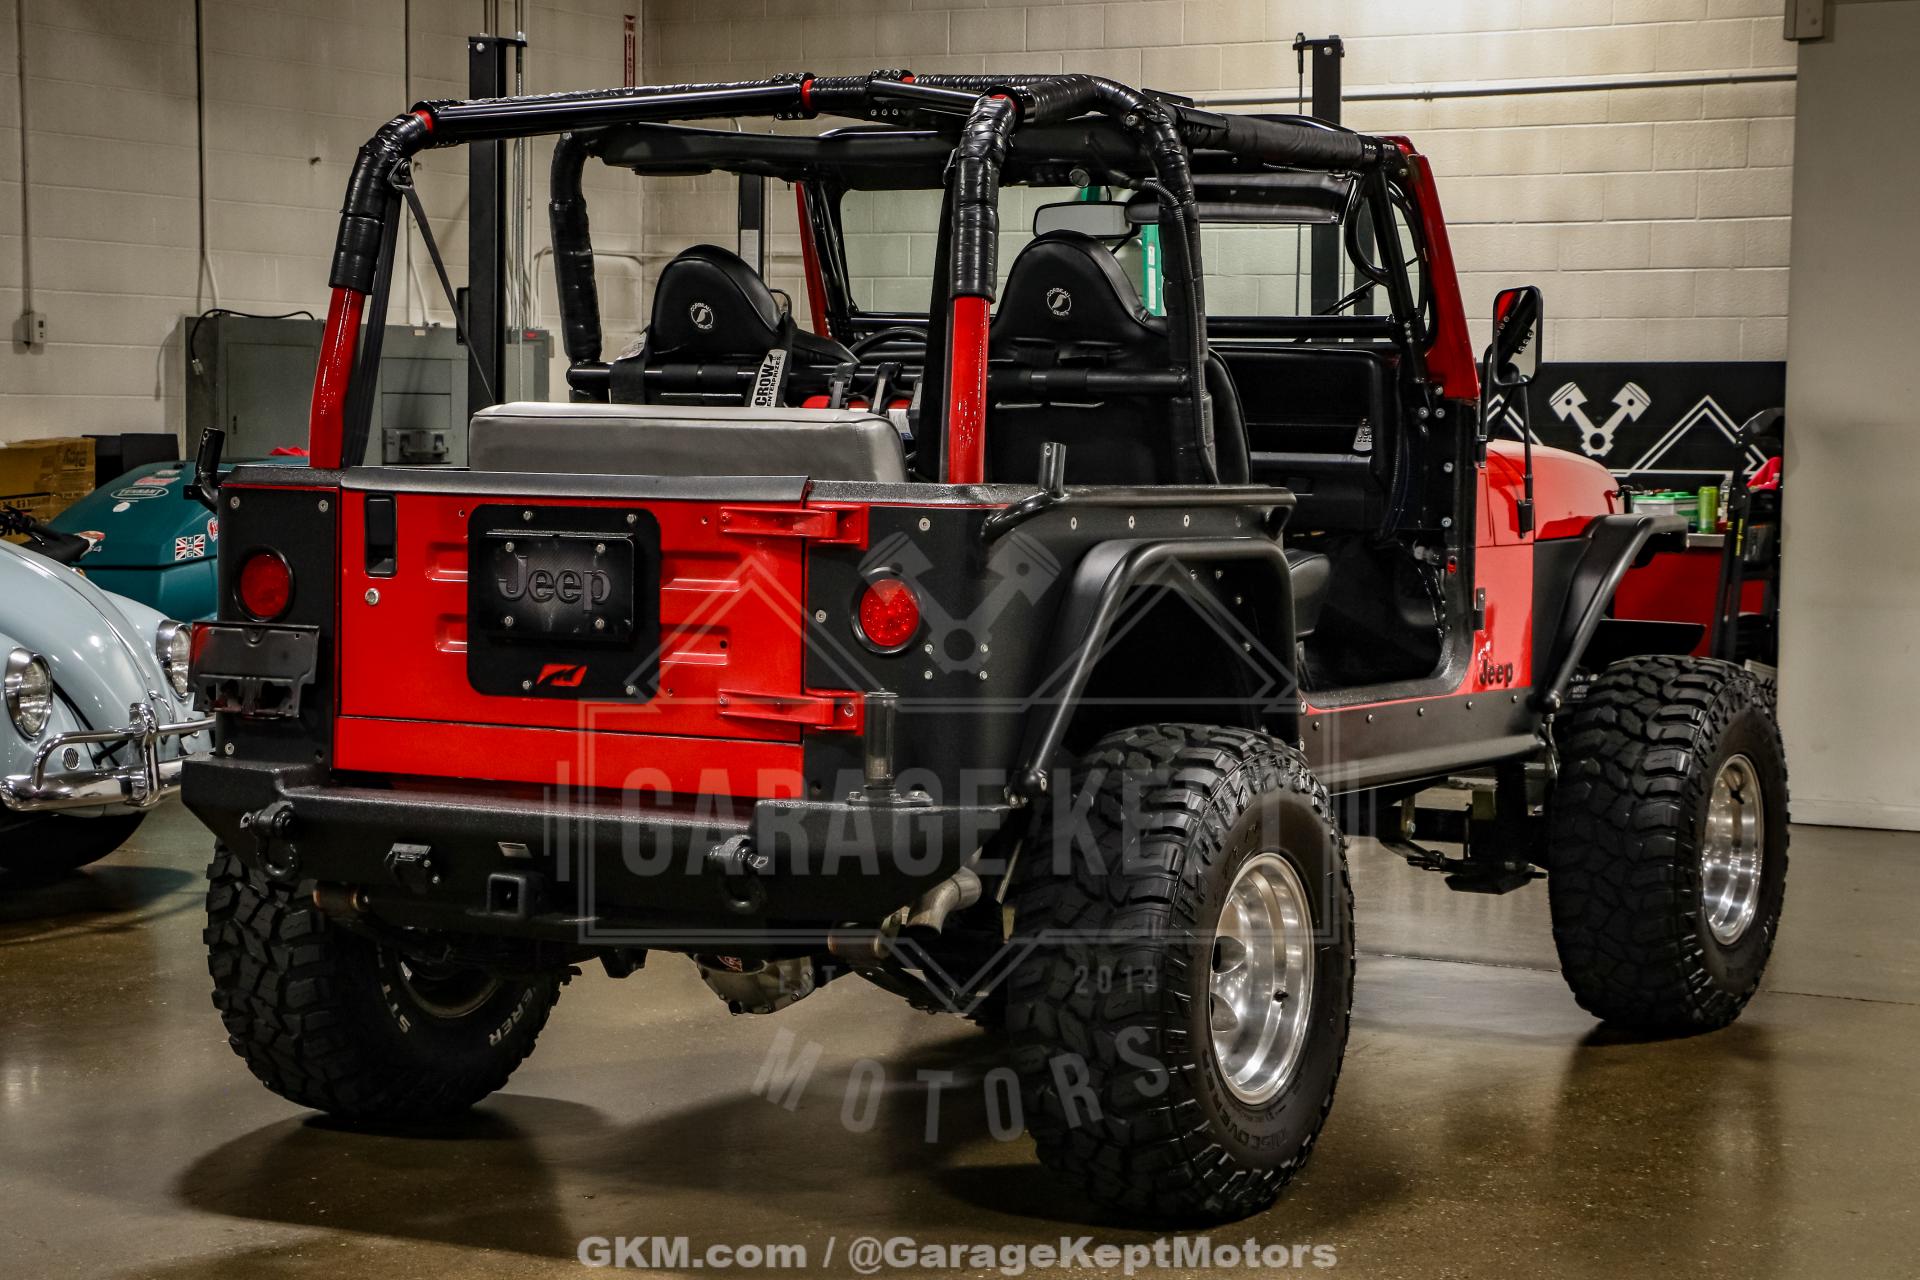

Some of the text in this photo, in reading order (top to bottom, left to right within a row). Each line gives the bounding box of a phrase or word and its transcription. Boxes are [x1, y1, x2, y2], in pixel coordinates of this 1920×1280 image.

[754, 363, 775, 407] CROW
[498, 555, 612, 613] Jeep
[1479, 659, 1513, 688] Jeep
